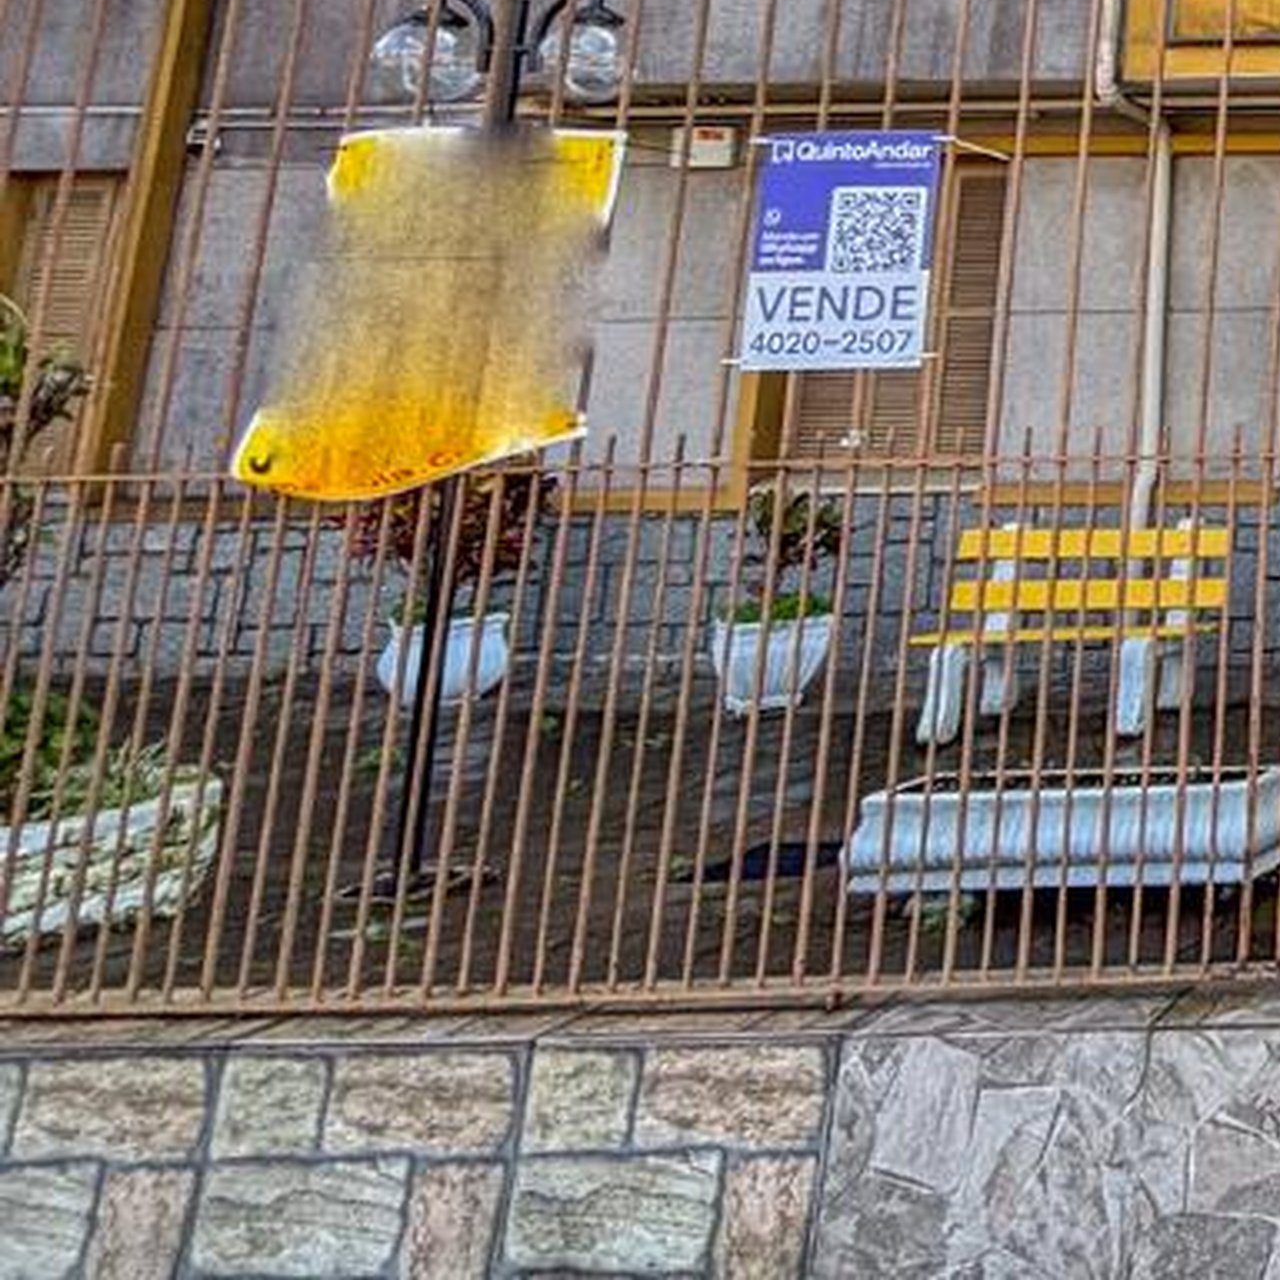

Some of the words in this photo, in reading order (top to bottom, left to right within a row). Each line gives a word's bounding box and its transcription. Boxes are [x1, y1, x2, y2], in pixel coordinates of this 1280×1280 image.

[796, 141, 934, 161] QuintoAndar
[757, 285, 918, 322] VENDE
[749, 329, 914, 355] 4020-2507
